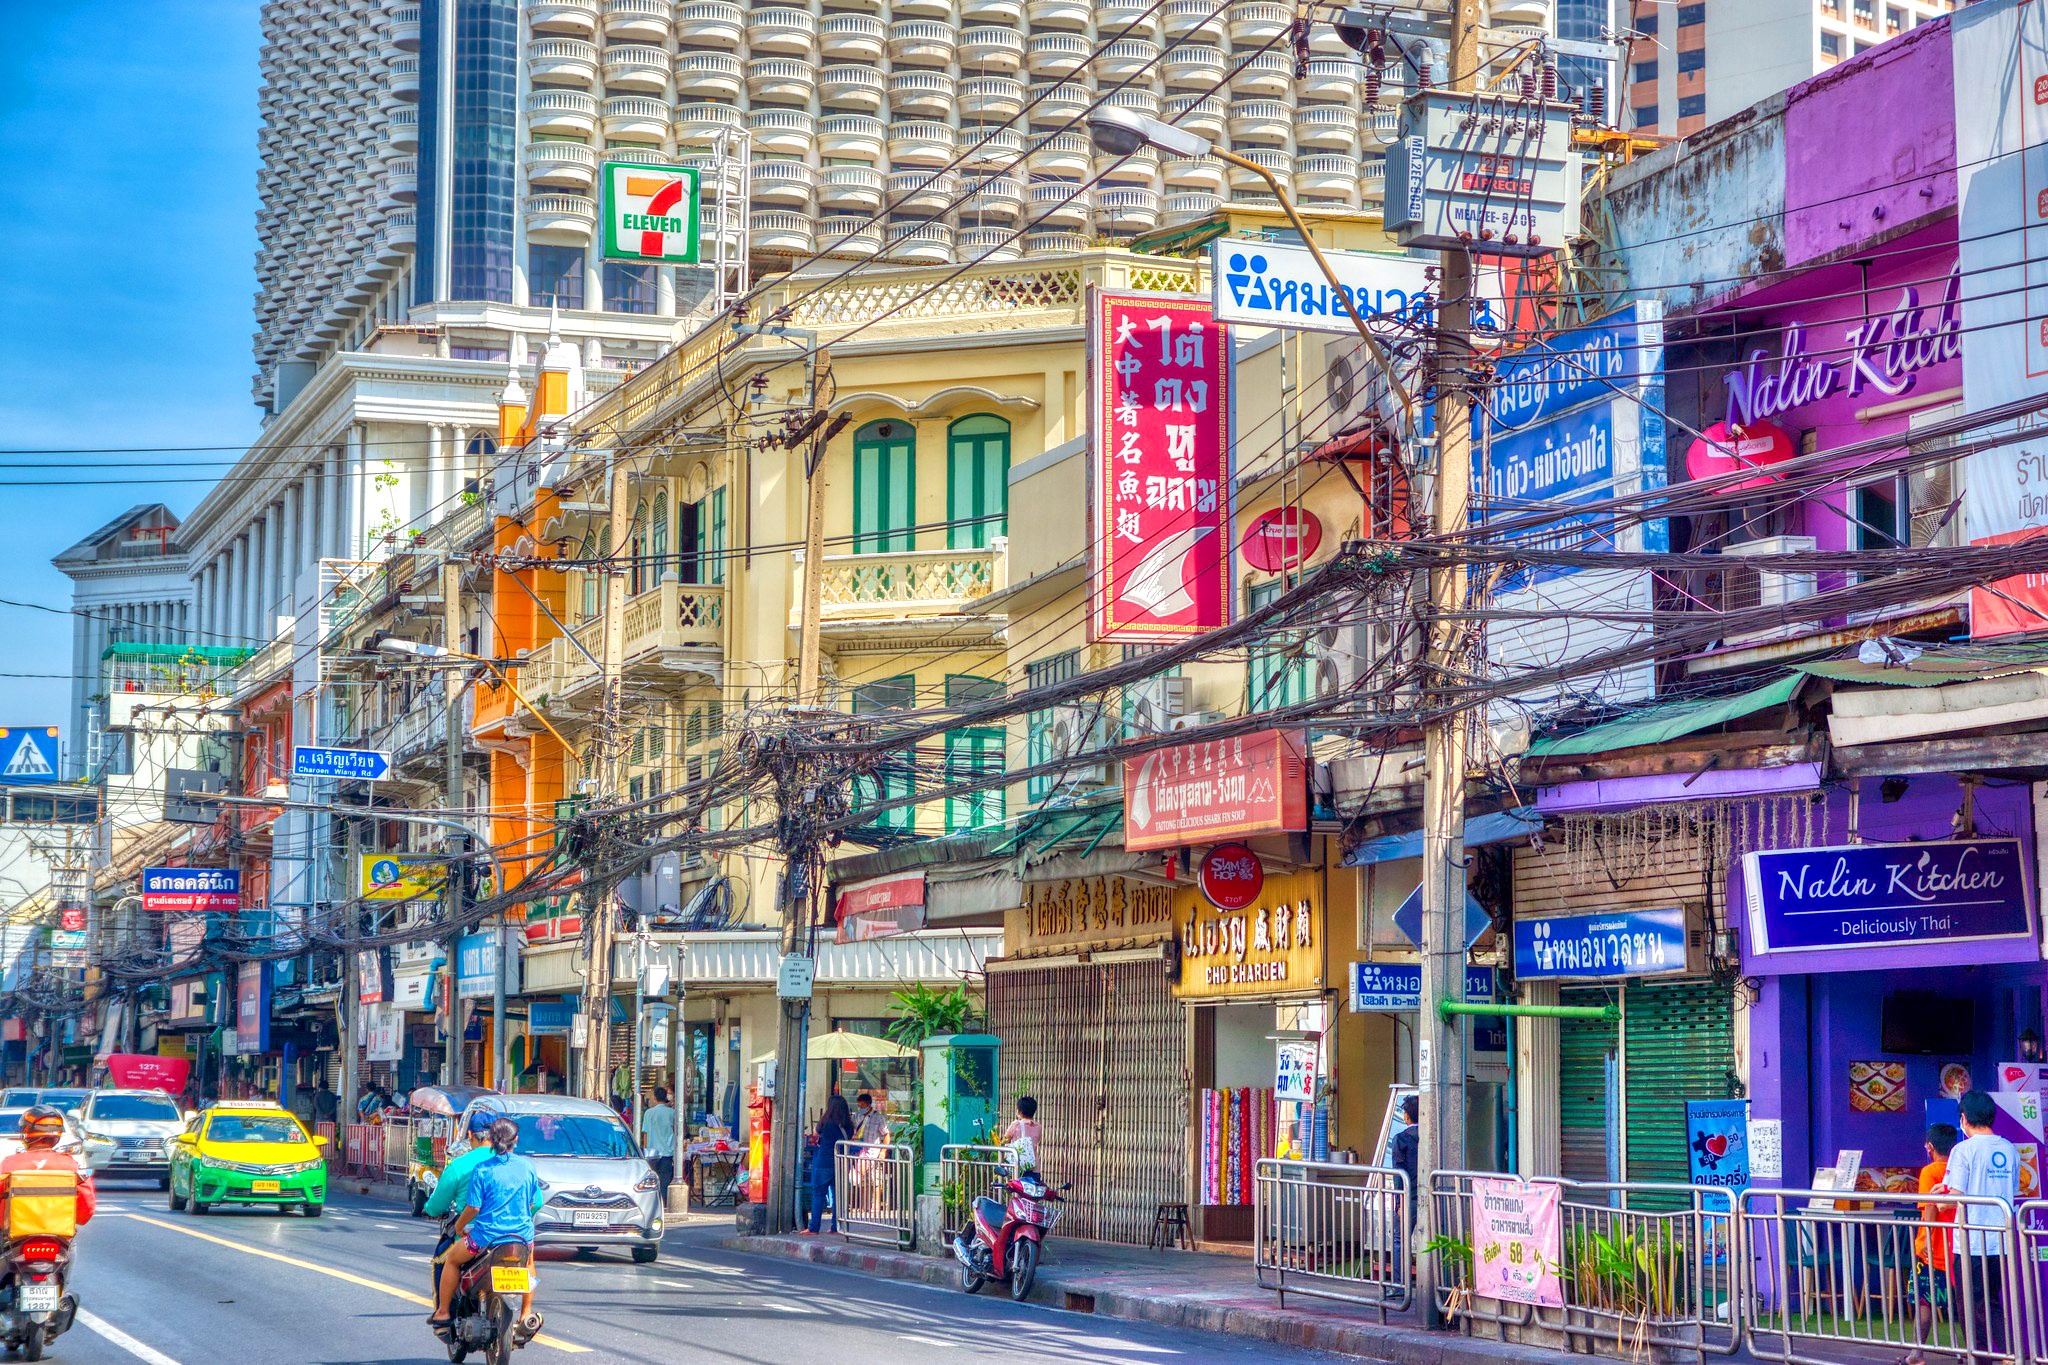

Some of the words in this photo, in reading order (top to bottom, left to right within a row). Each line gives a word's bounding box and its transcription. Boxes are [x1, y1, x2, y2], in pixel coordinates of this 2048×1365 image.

[1484, 157, 1510, 173] 225
[1481, 177, 1531, 194] PRECISE
[626, 176, 683, 257] 7
[1723, 320, 1843, 434] Nalin
[311, 751, 374, 768] เจริญเวียง
[298, 766, 329, 775] Charoen
[334, 769, 357, 777] Wiang
[1177, 815, 1204, 830] DELICIOUS
[1203, 813, 1222, 827] SHARK
[1221, 811, 1231, 825] FIN
[149, 872, 235, 890] สกลคลินิก
[1777, 856, 1876, 900] Nalin
[1885, 847, 2005, 901] Kitchen
[1842, 916, 1917, 936] Deliciously
[1920, 915, 1951, 930] Thai
[1552, 931, 1665, 970] หมอมวลชน
[1205, 965, 1228, 984] CHO
[1231, 961, 1288, 983] CHAROEN
[139, 1063, 160, 1071] 1271
[2022, 1105, 2038, 1120] 5G
[1728, 1132, 1739, 1144] 50
[1703, 1153, 1715, 1164] 50
[1695, 1164, 1748, 1186] คนละครึ่ง
[1484, 1189, 1524, 1214] ข้าวราดแกง
